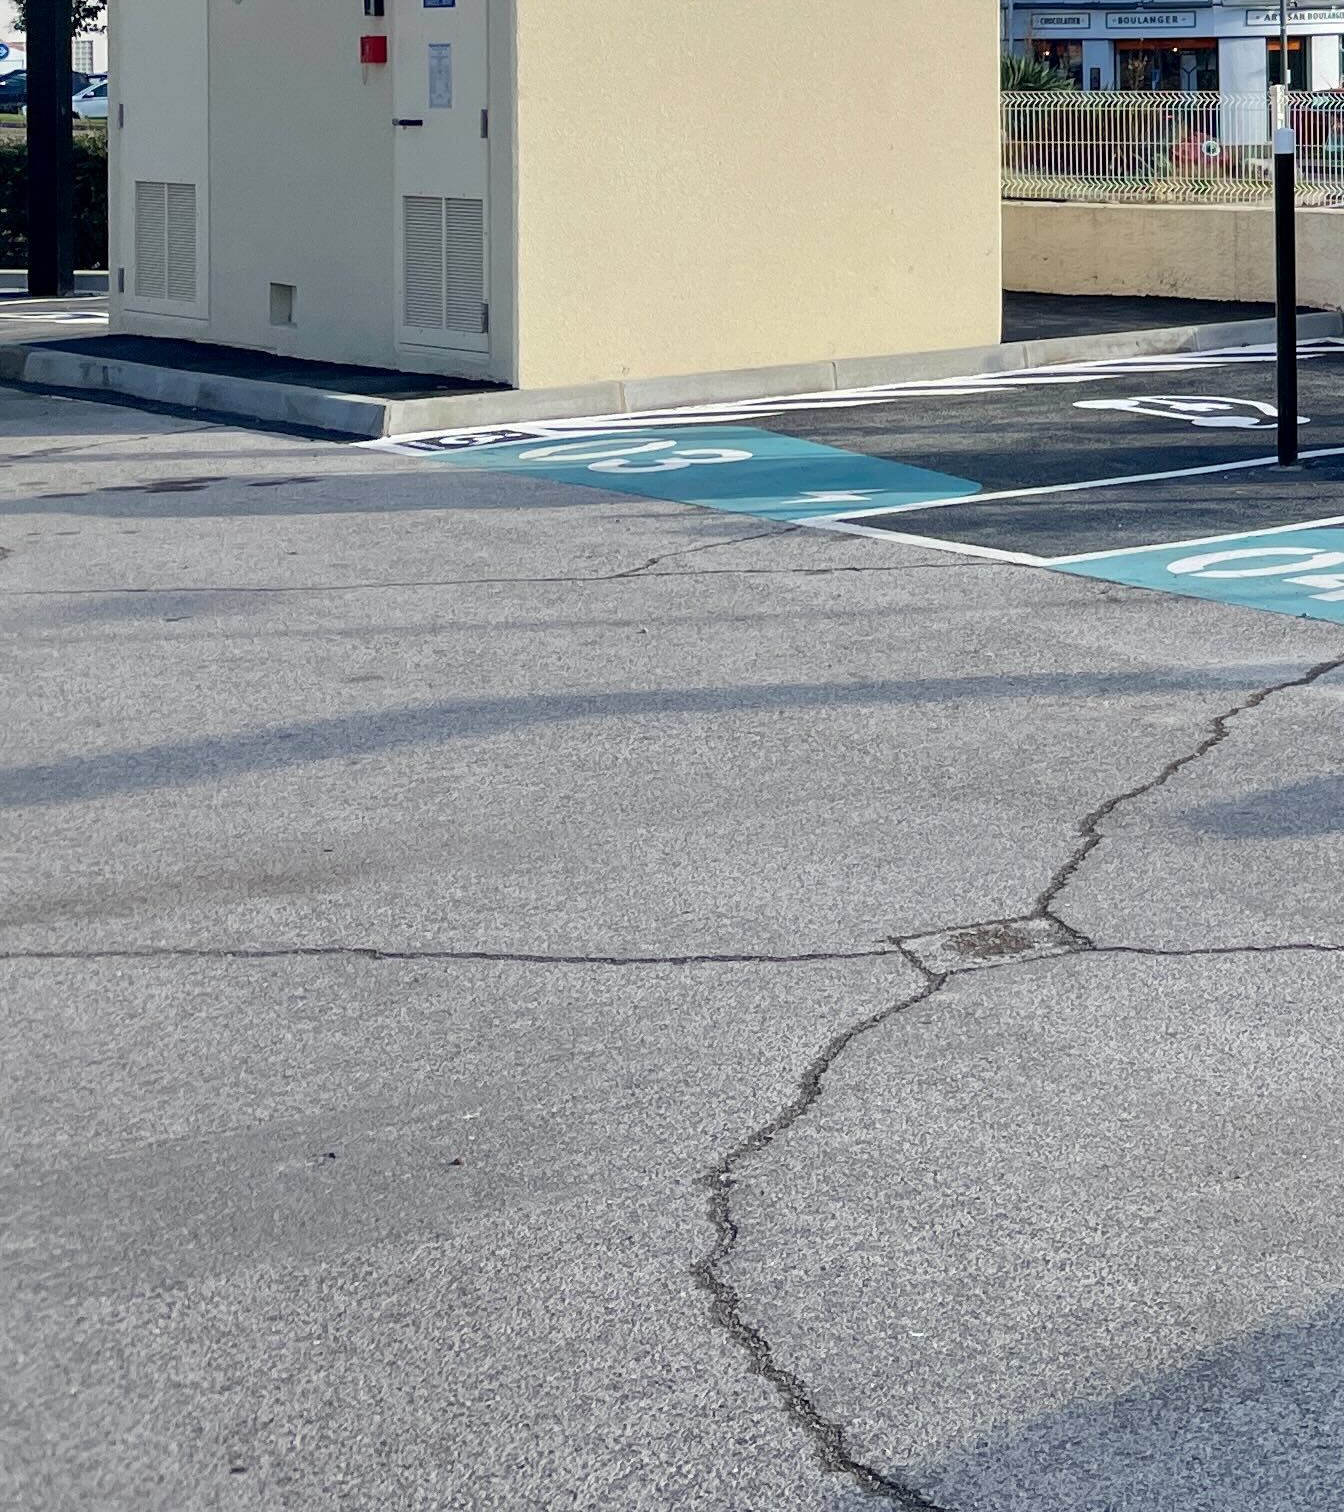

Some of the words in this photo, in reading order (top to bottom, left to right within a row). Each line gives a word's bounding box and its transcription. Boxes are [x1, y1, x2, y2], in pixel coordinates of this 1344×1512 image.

[1118, 15, 1178, 25] BOULANGER
[1264, 13, 1305, 22] ARSAN
[518, 437, 753, 474] 03
